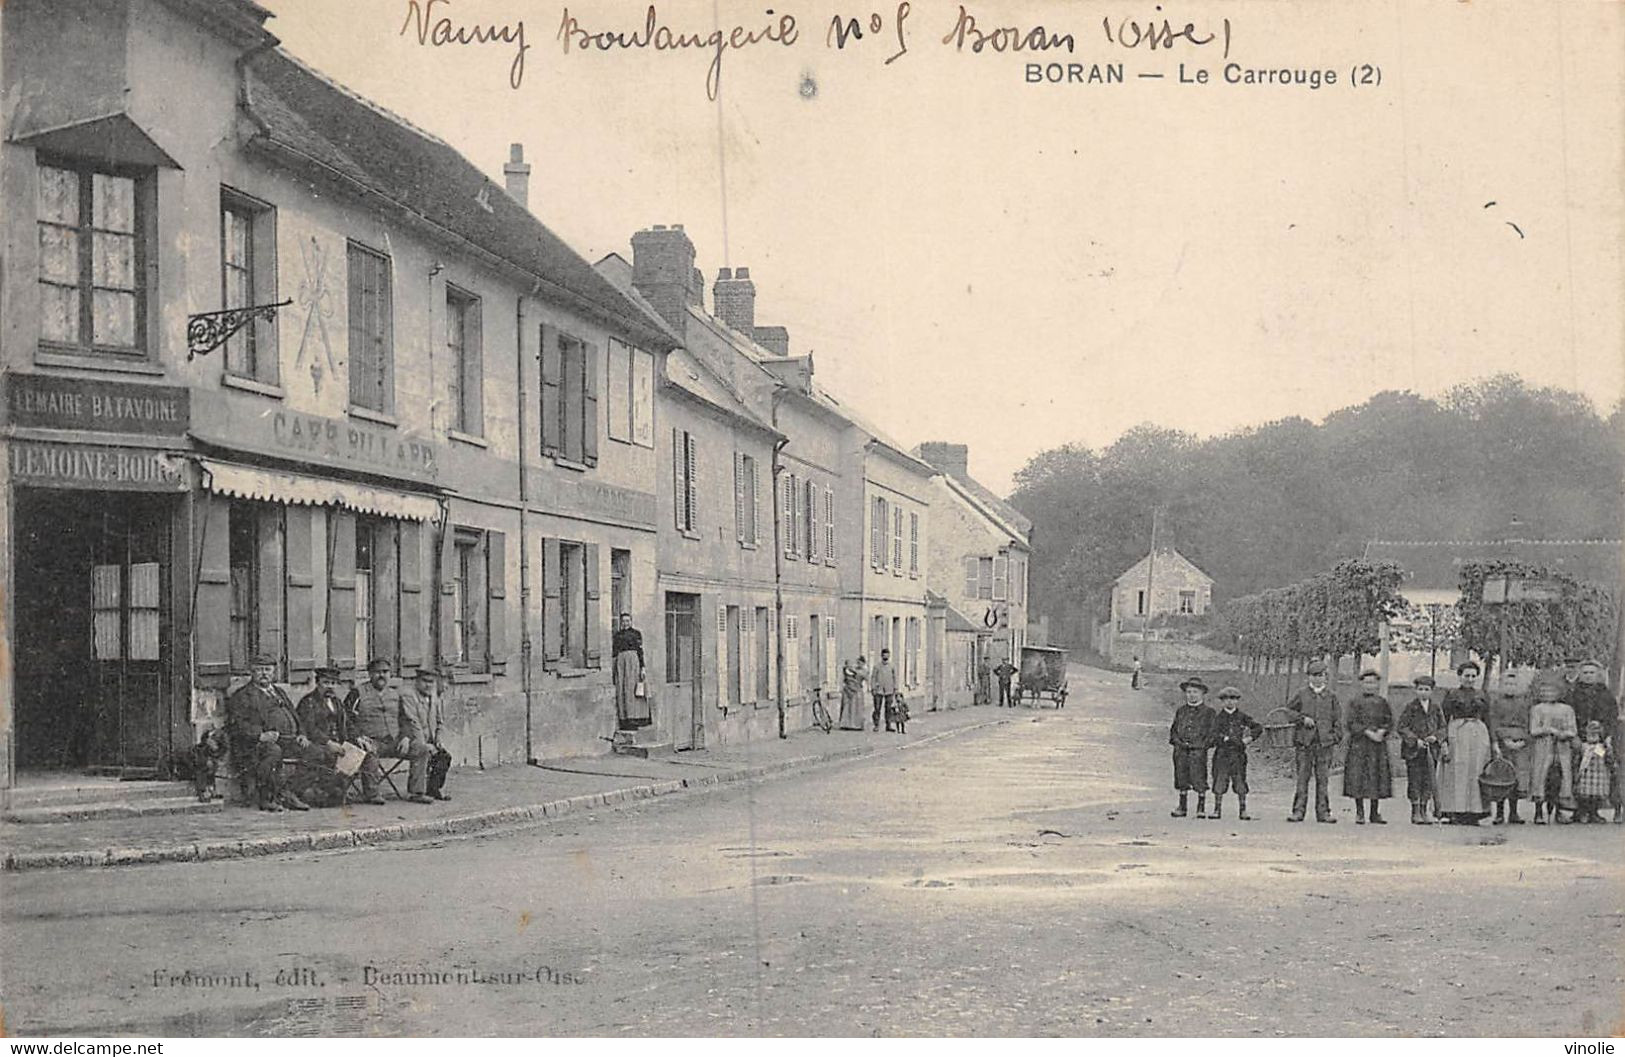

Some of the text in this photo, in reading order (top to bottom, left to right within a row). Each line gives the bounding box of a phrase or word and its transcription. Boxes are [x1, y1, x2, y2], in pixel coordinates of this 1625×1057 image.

[942, 5, 1075, 54] Boran
[15, 390, 178, 422] LEMAIRE BATAVOINE
